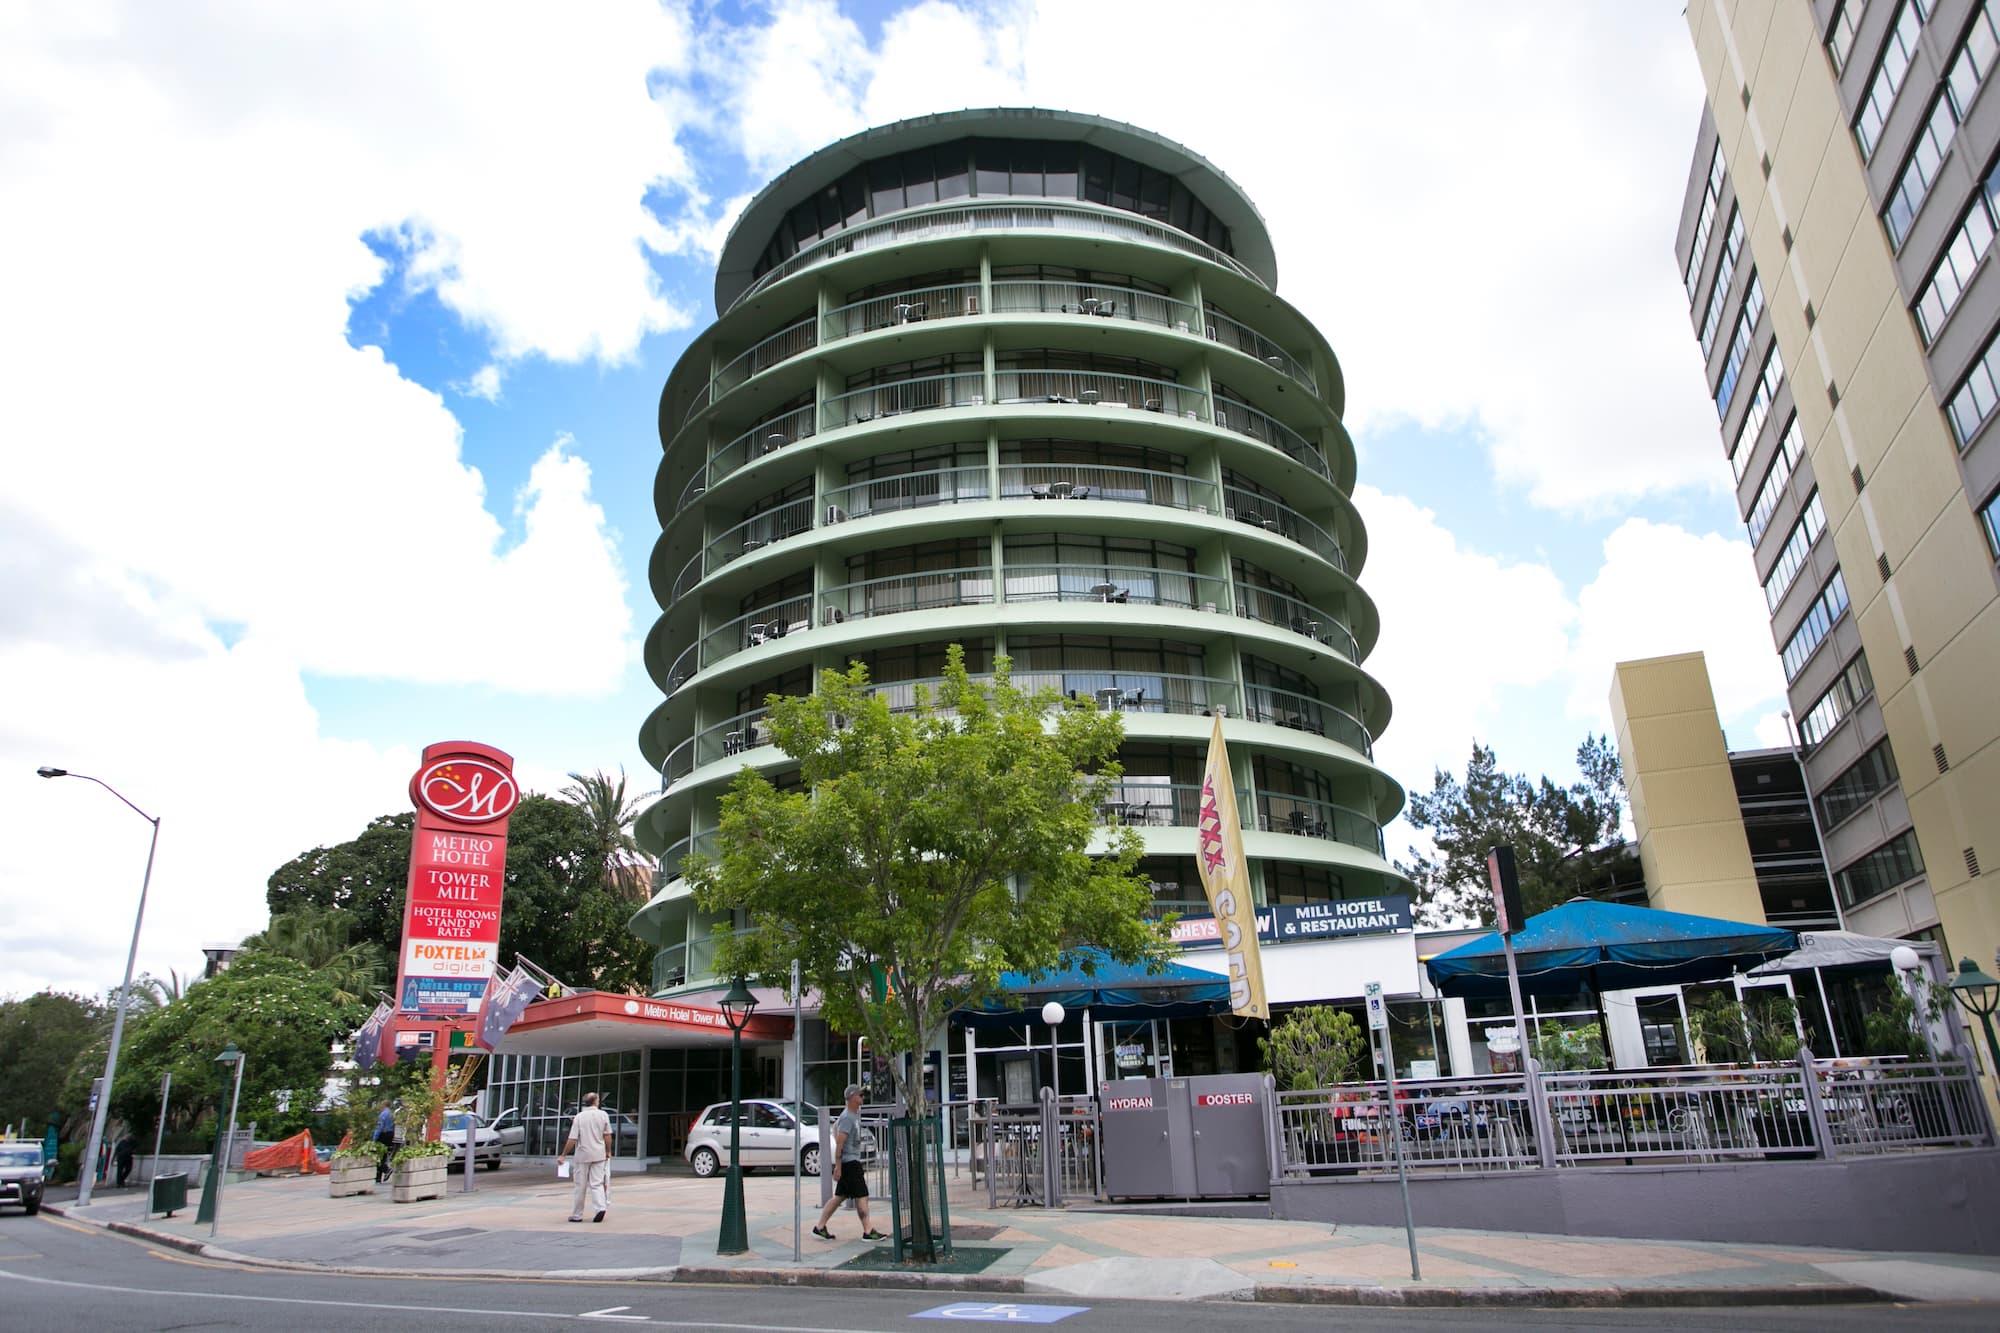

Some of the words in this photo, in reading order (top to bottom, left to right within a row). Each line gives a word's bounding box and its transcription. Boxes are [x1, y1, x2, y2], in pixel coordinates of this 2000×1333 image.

[432, 835, 493, 853] METRO
[433, 850, 490, 866] HOTEL
[428, 870, 490, 888] TOWER
[437, 886, 479, 901] MILL
[414, 907, 453, 918] HOTEL
[455, 909, 497, 921] ROOMS
[1296, 905, 1333, 919] MILL
[1336, 900, 1385, 916] HOTEL
[426, 917, 466, 928] STAND
[469, 919, 483, 929] BY
[1284, 922, 1296, 935] &
[1301, 913, 1400, 933] RESTAURANT
[437, 927, 472, 938] RATES
[414, 944, 471, 961] FOXTEL
[432, 961, 485, 975] digital
[1366, 983, 1380, 996] 3P
[644, 1003, 668, 1018] Metro
[669, 1007, 690, 1020] Hotel
[692, 1010, 714, 1024] Tower
[1109, 1097, 1153, 1109] HYDRAN
[1206, 1093, 1253, 1106] OOSTER
